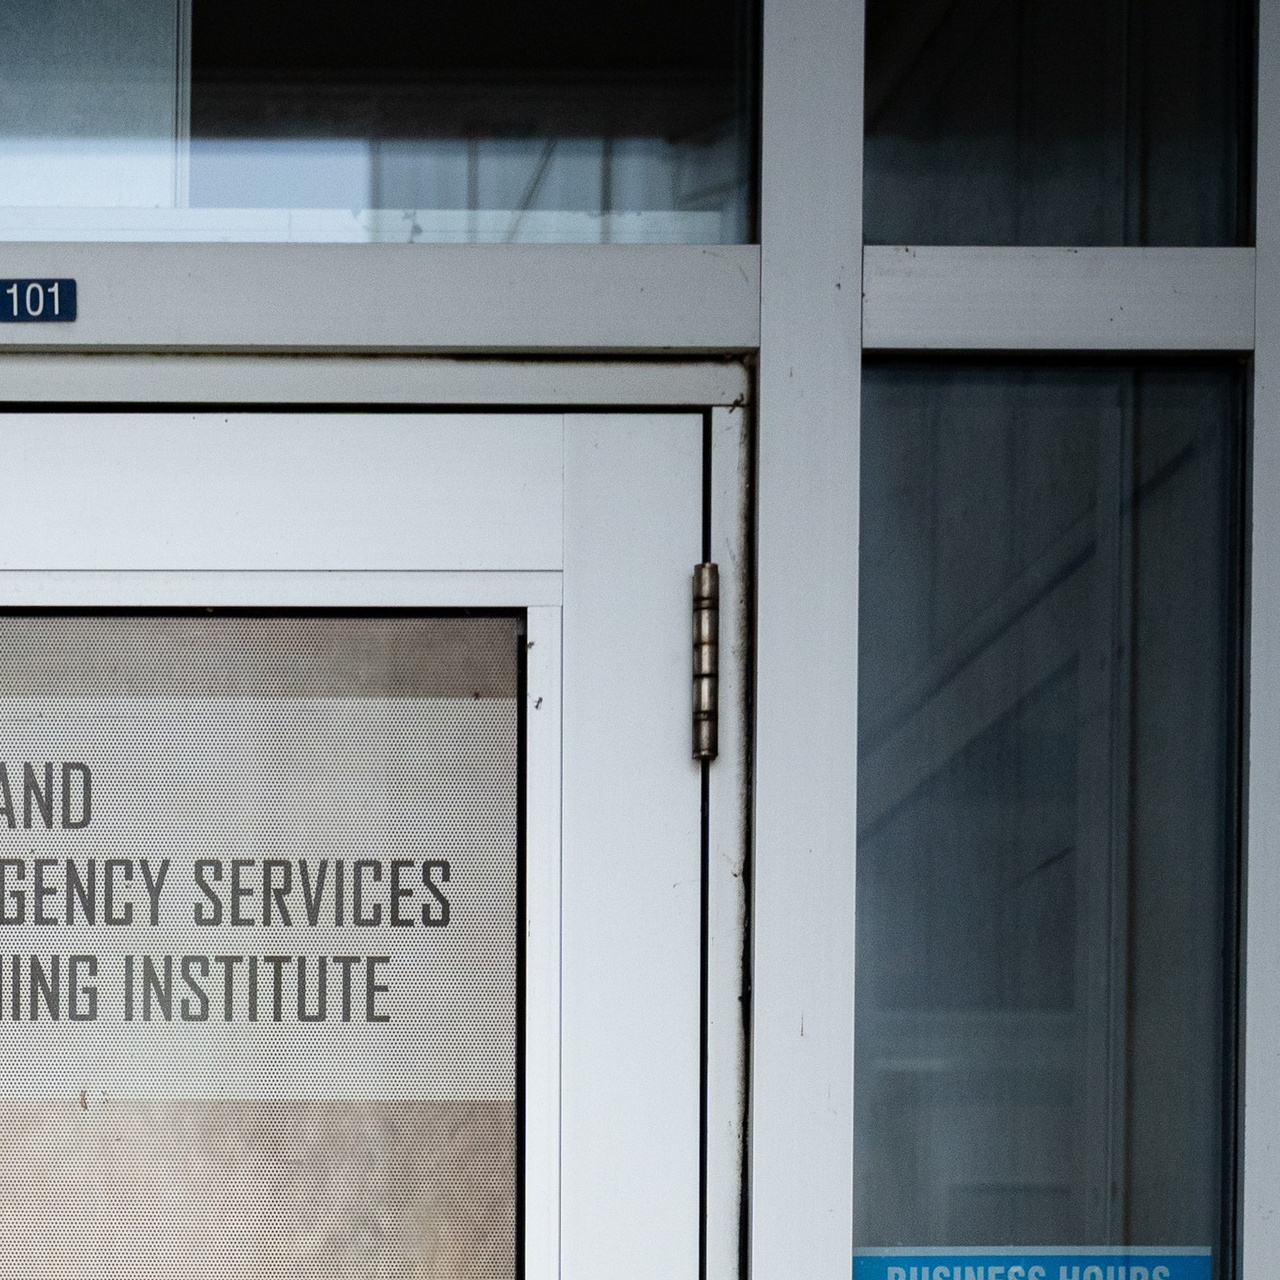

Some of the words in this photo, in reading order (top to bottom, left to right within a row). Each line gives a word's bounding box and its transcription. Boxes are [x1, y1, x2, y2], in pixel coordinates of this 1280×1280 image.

[6, 282, 59, 316] 101
[194, 858, 451, 927] SERVICES
[123, 955, 392, 1023] INSTITUTE
